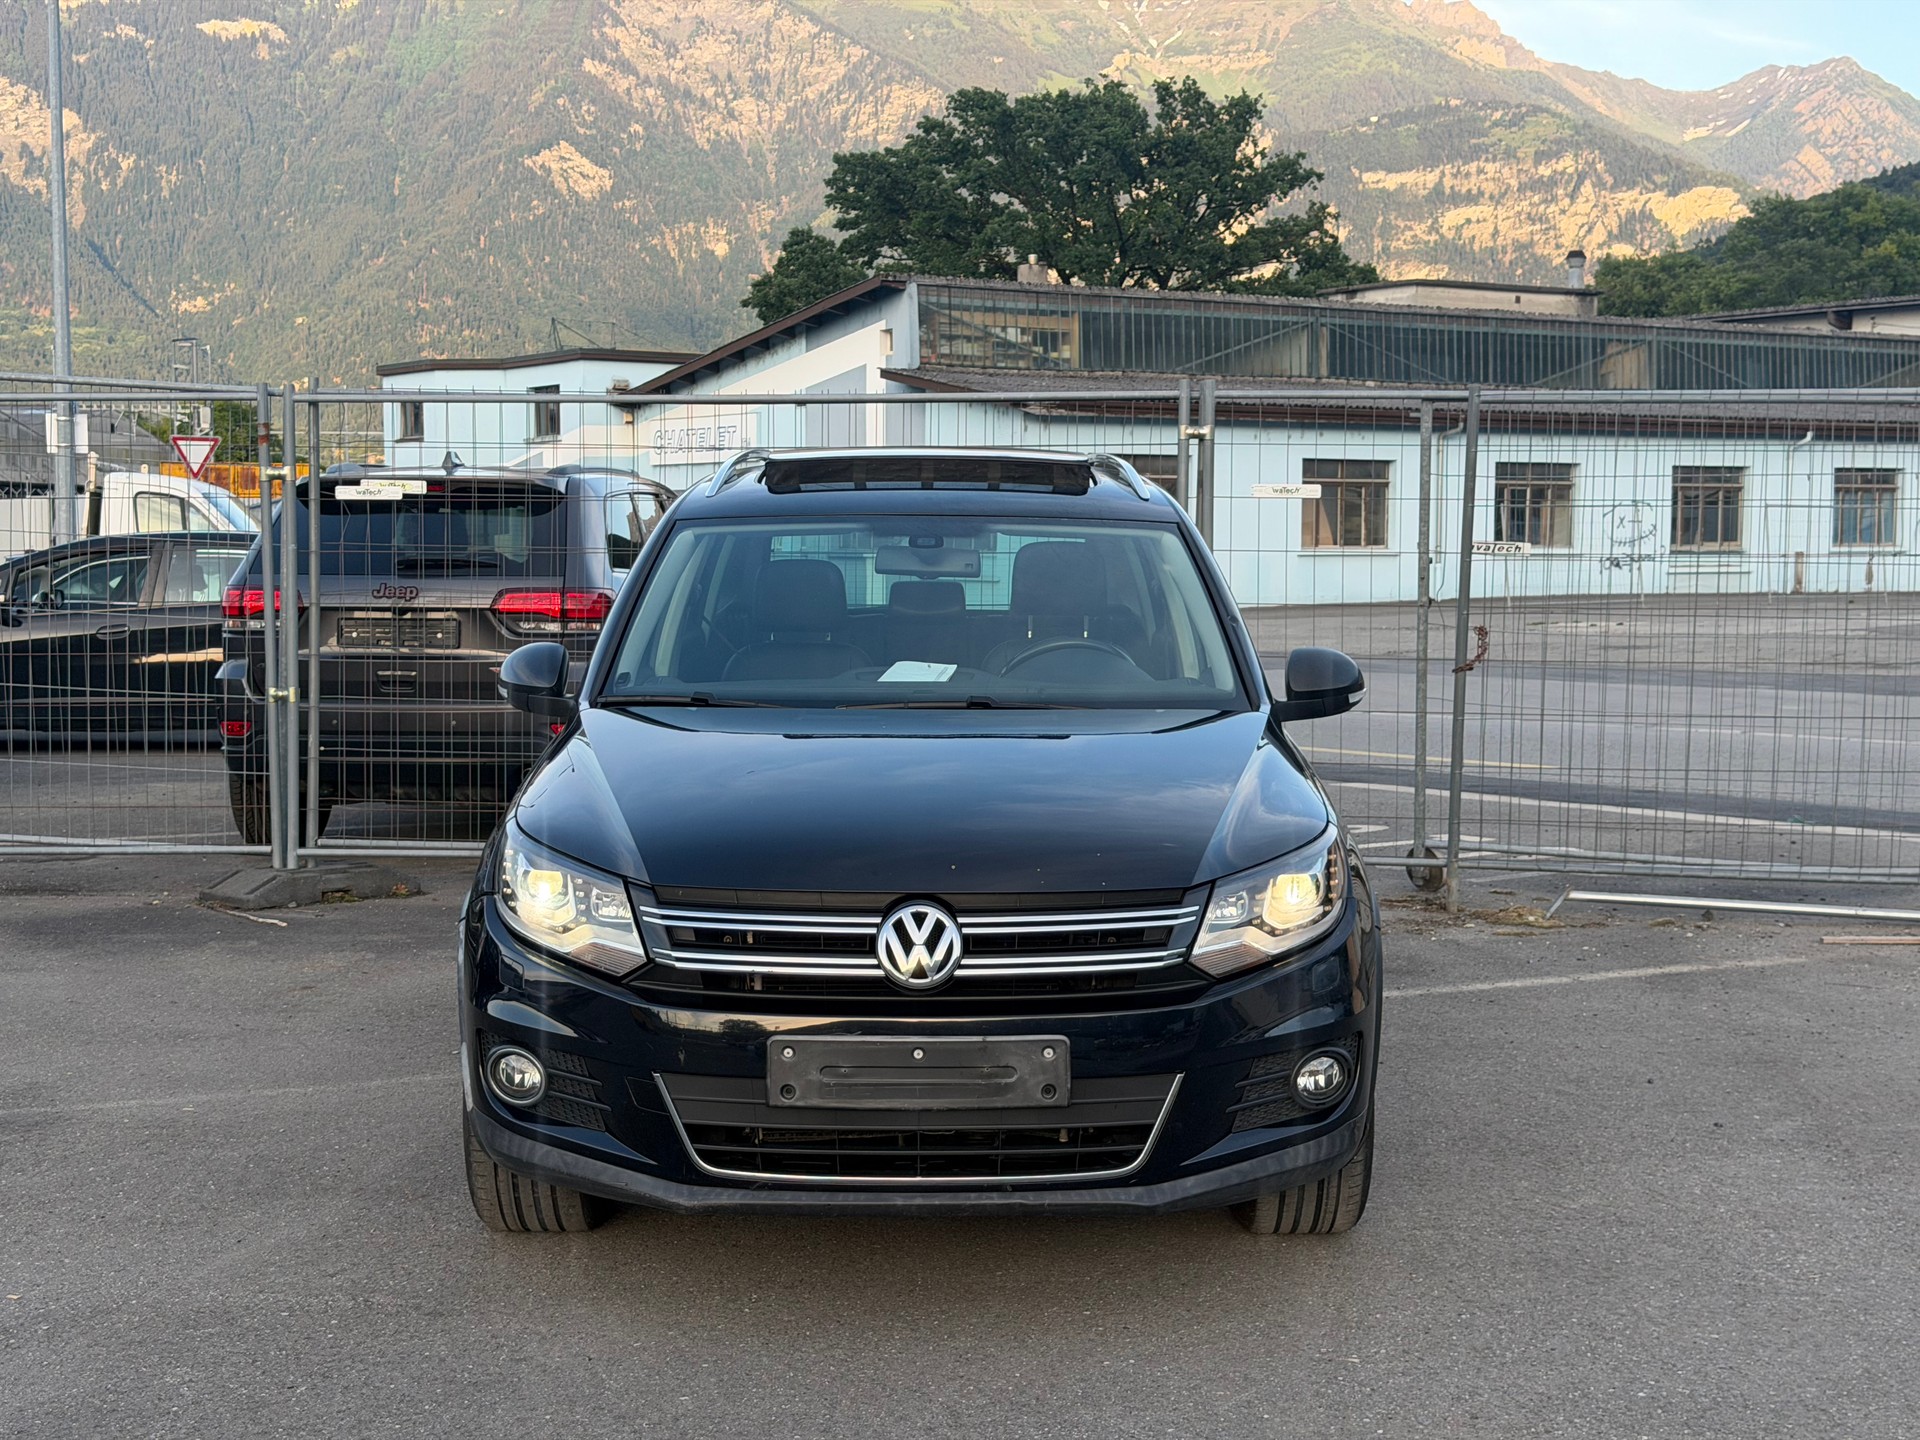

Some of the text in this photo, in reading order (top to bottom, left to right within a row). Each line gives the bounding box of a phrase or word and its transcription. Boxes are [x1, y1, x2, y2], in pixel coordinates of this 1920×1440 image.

[653, 425, 738, 455] CHATELET
[371, 582, 419, 602] Jeep
[880, 904, 960, 984] VW
